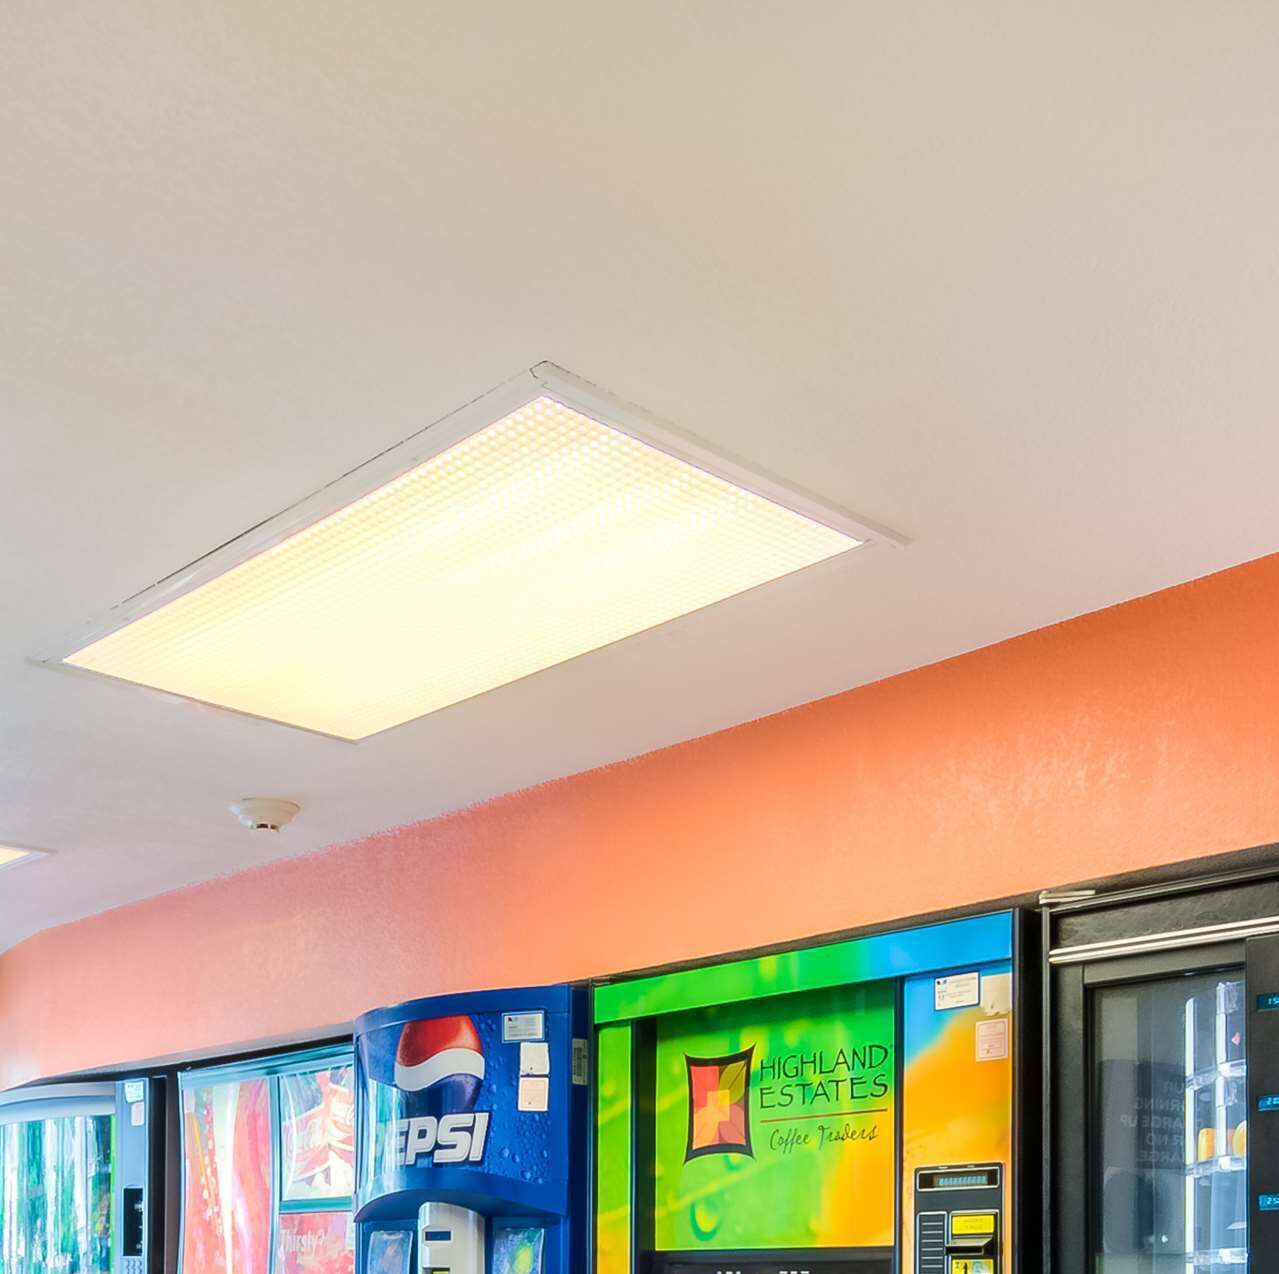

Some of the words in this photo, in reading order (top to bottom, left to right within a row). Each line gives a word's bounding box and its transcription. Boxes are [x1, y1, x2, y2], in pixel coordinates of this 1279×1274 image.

[759, 1044, 889, 1082] HIGHLAND
[759, 1073, 889, 1109] ESTATES
[395, 1112, 489, 1165] EPSI
[769, 1128, 810, 1155] Coffee
